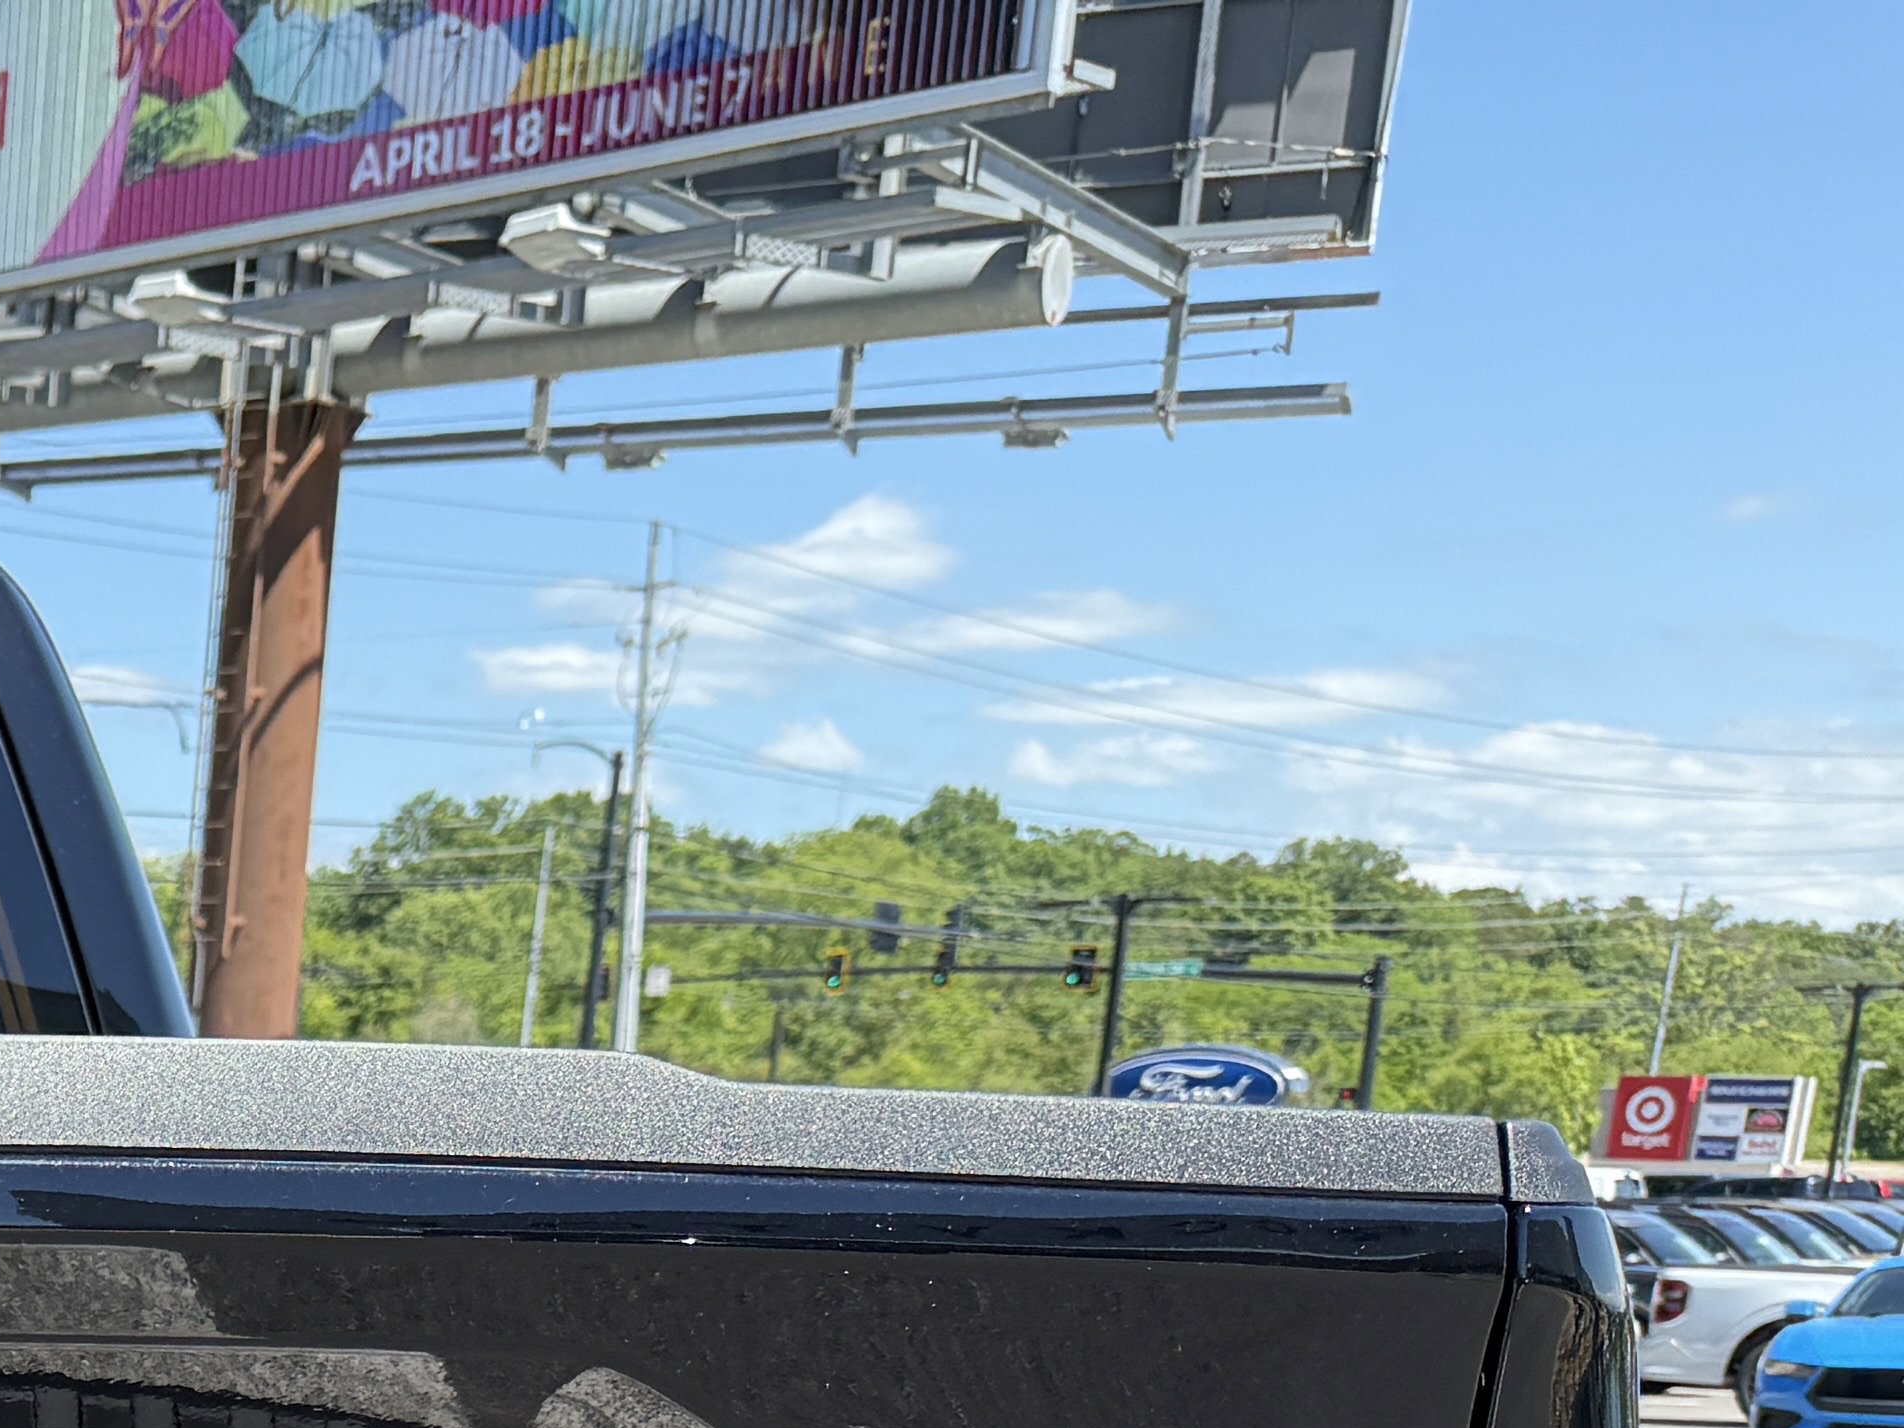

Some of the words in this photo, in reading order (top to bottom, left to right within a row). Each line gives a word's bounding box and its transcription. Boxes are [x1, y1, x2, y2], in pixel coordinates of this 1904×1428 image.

[348, 119, 480, 194] APRIL
[491, 107, 545, 164] 18
[583, 73, 710, 148] JUNE
